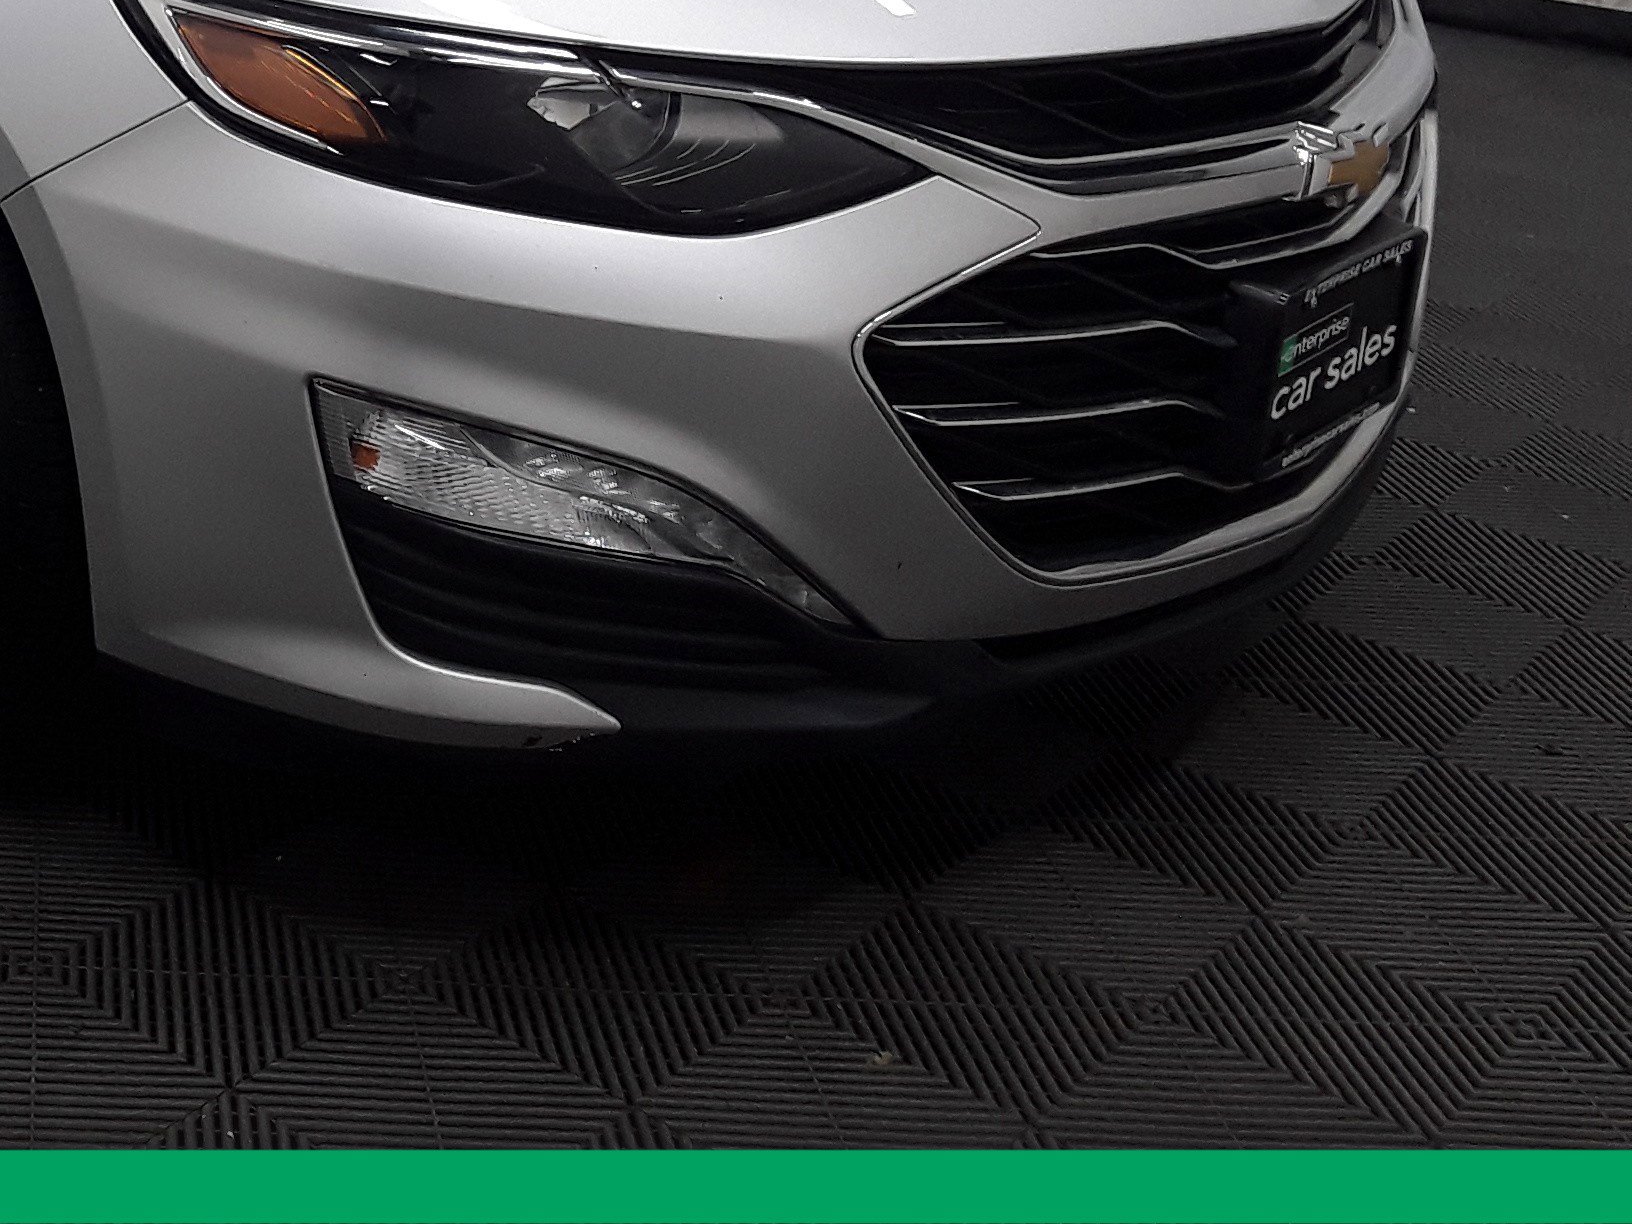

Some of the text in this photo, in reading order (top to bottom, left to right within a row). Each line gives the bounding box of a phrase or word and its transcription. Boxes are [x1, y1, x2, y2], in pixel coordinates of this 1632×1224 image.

[1270, 324, 1397, 420] car sales
[1280, 316, 1350, 363] enterprise
